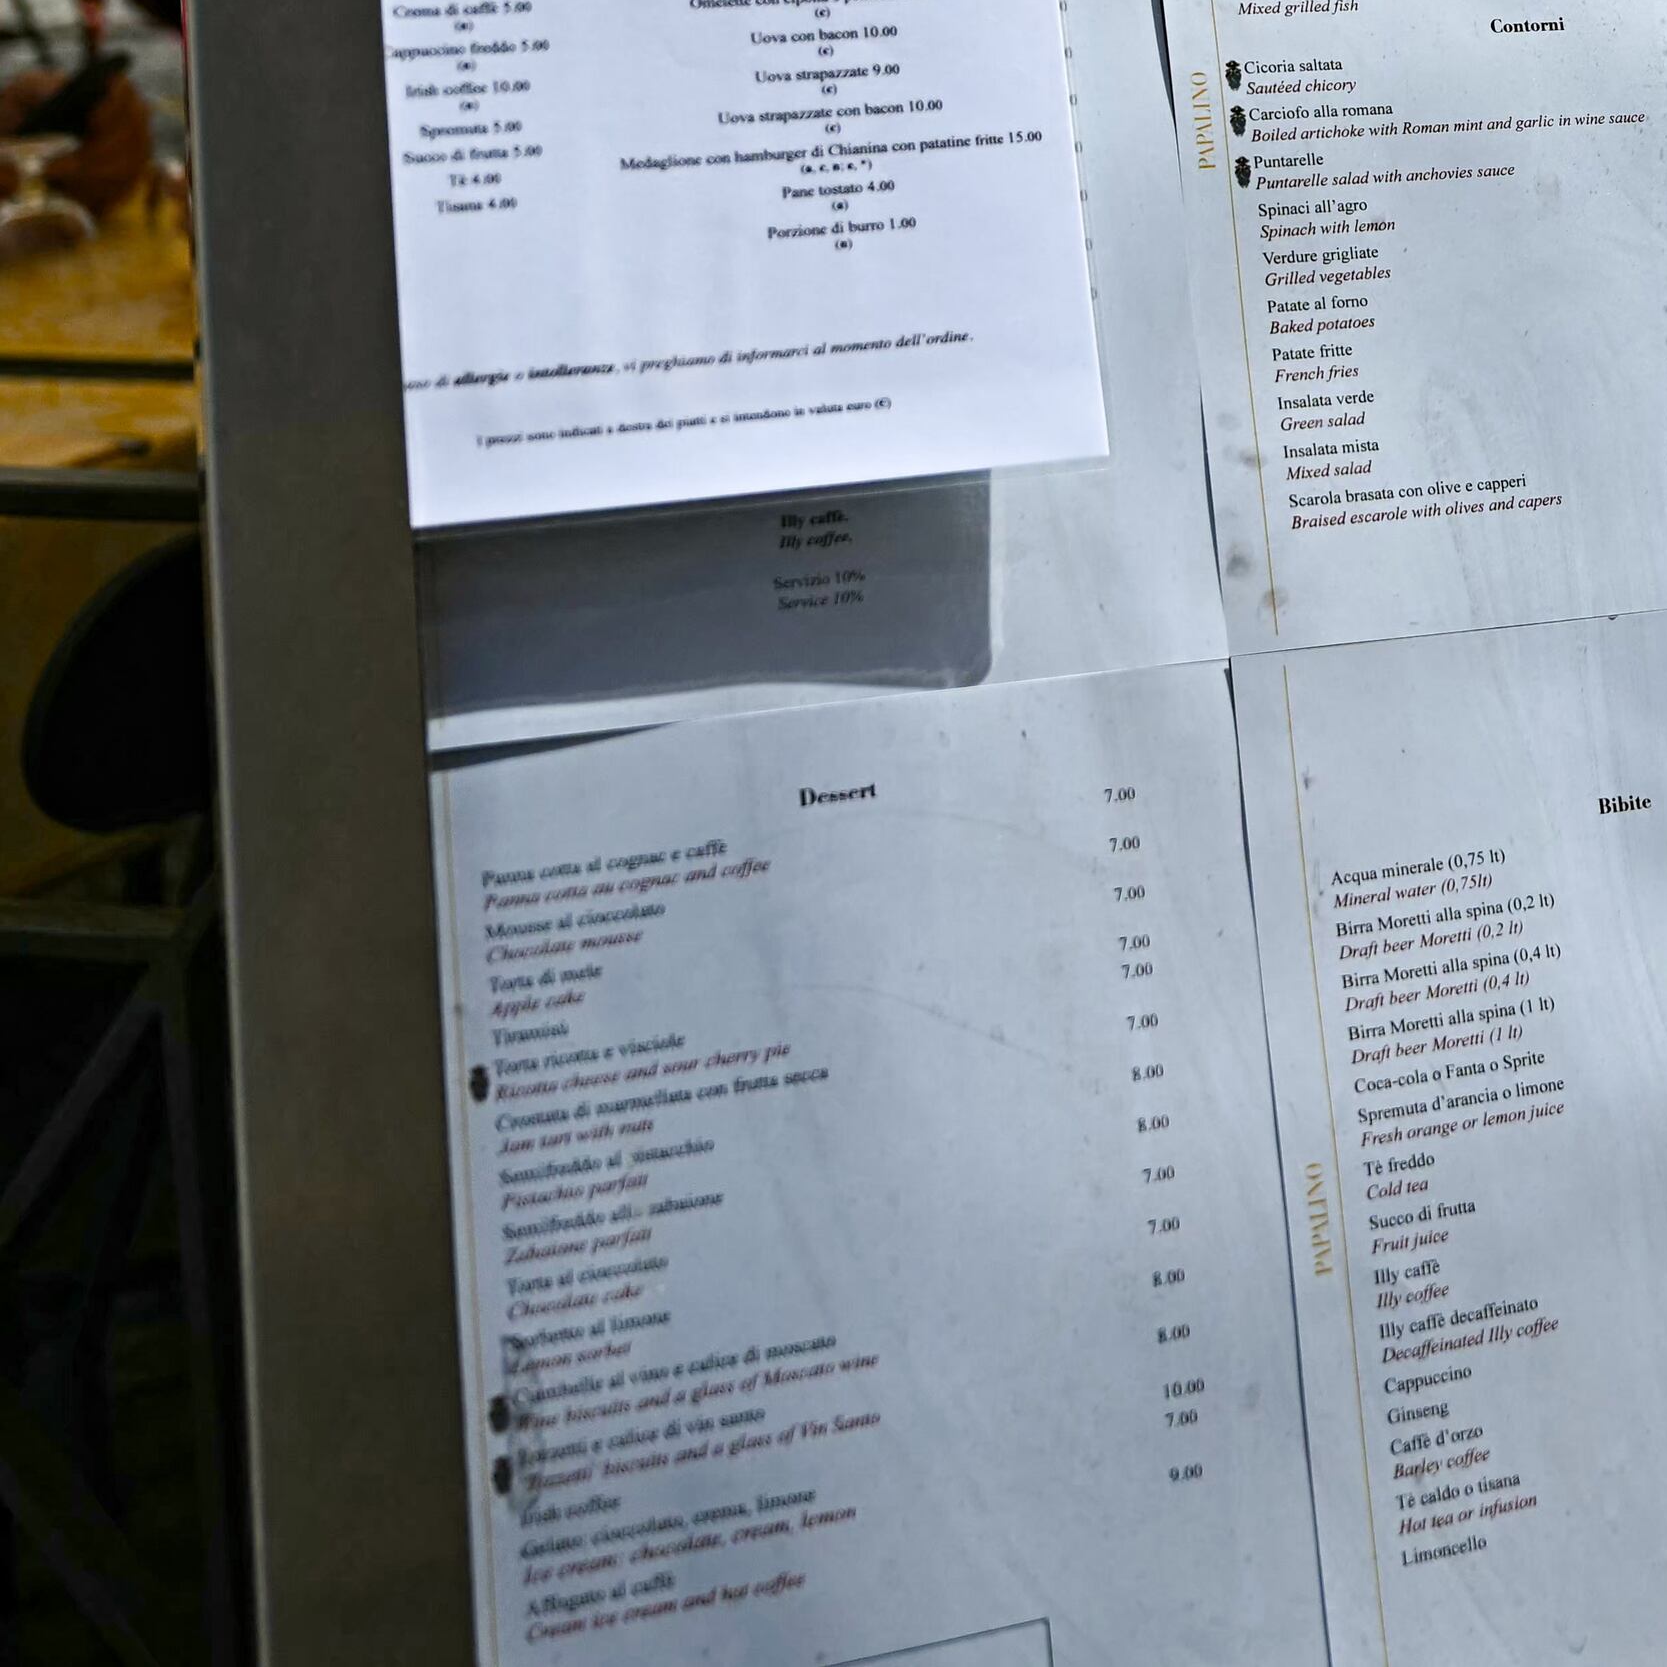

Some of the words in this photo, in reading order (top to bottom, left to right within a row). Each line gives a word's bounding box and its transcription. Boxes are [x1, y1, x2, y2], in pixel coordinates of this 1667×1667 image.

[1491, 17, 1564, 33] Contorni
[1244, 60, 1295, 74] Cicoria
[1299, 59, 1343, 71] saltata
[1247, 80, 1301, 94] Sautéed
[1305, 79, 1356, 93] chicory
[1190, 71, 1215, 170] PAPALINO
[1254, 153, 1323, 168] Puntarelle
[867, 180, 895, 192] 4.00
[1268, 300, 1309, 313] Patate
[1315, 297, 1326, 310] al
[1332, 296, 1368, 309] forno
[1275, 366, 1324, 382] French
[1326, 365, 1358, 382] fries
[1281, 417, 1322, 431] Green
[1328, 411, 1365, 427] salad
[800, 784, 876, 806] Dessert
[1105, 787, 1135, 802] 7.00
[1599, 795, 1651, 814] Bibite
[1127, 1013, 1158, 1030] 7.00
[1355, 1070, 1428, 1093] Coca-cola
[1433, 1070, 1441, 1081] o
[1446, 1063, 1485, 1078] Fanta
[1490, 1062, 1498, 1071] o
[1503, 1051, 1544, 1072] Sprite
[1388, 1152, 1435, 1172] freddo
[1367, 1180, 1402, 1200] Cold
[1407, 1180, 1428, 1193] tea
[1305, 1163, 1333, 1277] PAPALINO
[1369, 1214, 1413, 1230] Succo
[1418, 1205, 1431, 1222] di
[1437, 1202, 1475, 1218] frutta
[1164, 1379, 1204, 1399] 10.00
[1384, 1366, 1471, 1394] Cappuccino
[1387, 1403, 1449, 1424] Ginseng
[1402, 1535, 1487, 1566] Limoncello
